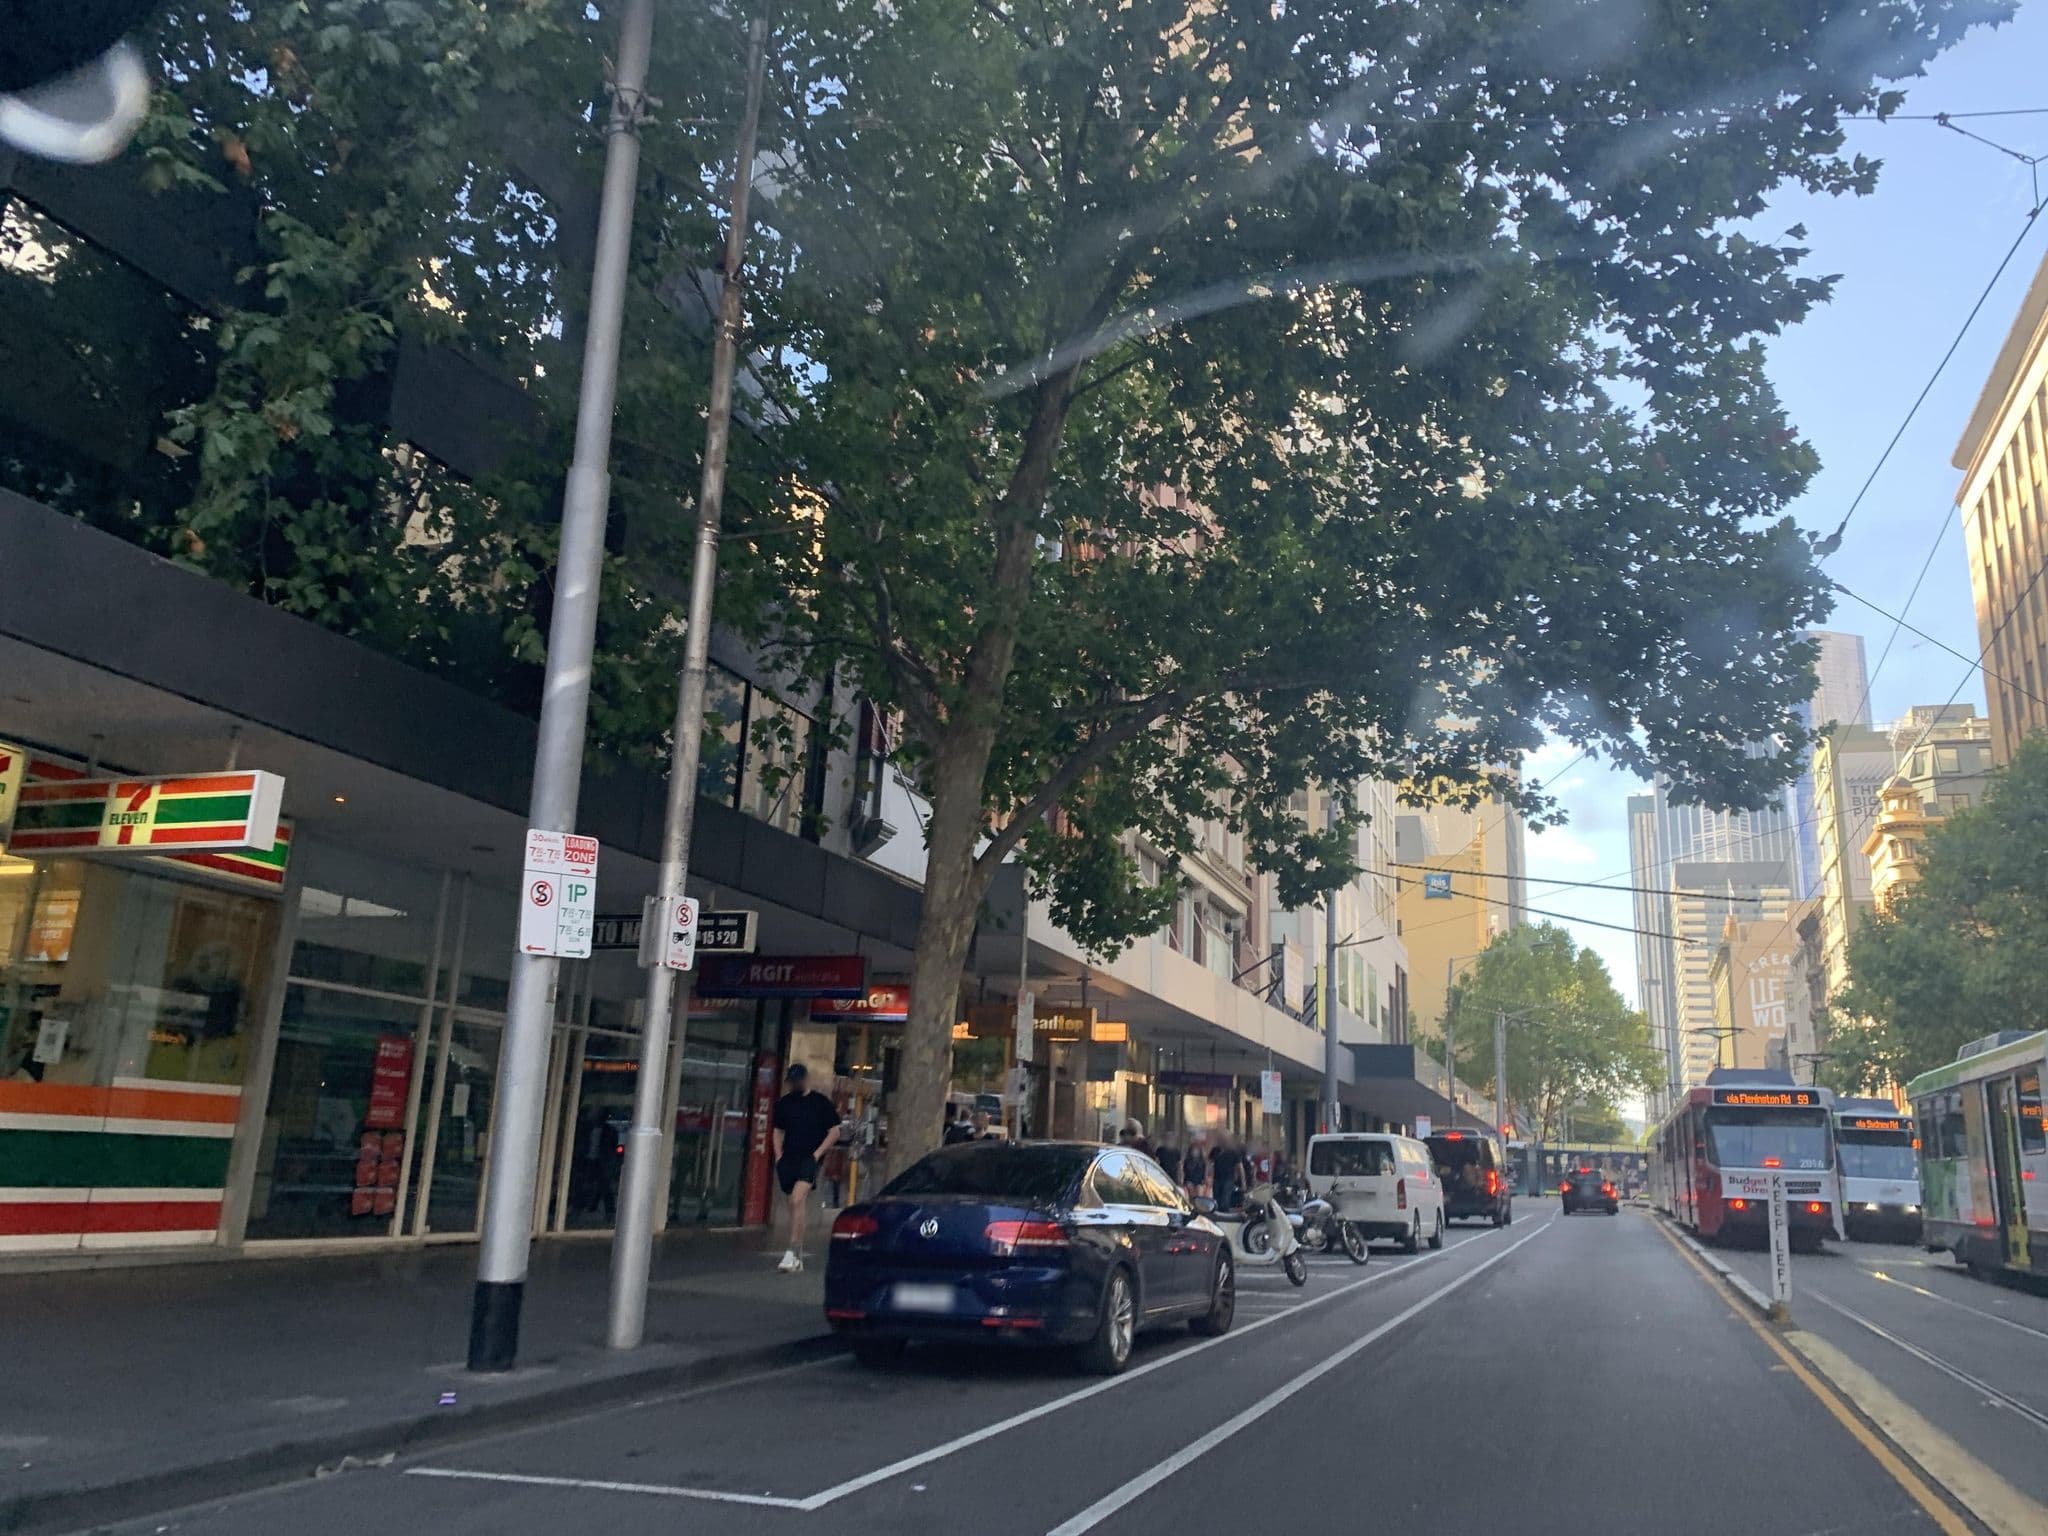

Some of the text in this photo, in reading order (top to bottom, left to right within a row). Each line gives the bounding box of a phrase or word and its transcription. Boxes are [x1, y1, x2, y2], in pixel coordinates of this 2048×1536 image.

[565, 850, 595, 865] ZONE
[568, 883, 588, 902] 1P
[1749, 953, 1791, 974] CREA
[750, 965, 794, 981] RGIT
[1011, 1015, 1084, 1031] eadtop
[1752, 1006, 1786, 1028] WO
[1780, 1093, 1791, 1104] Rd
[1797, 1093, 1809, 1104] 59
[1729, 1175, 1767, 1185] Budget
[1743, 1185, 1769, 1193] Dire
[1772, 1176, 1783, 1231] KEEP
[1776, 1239, 1786, 1296] LEFT
